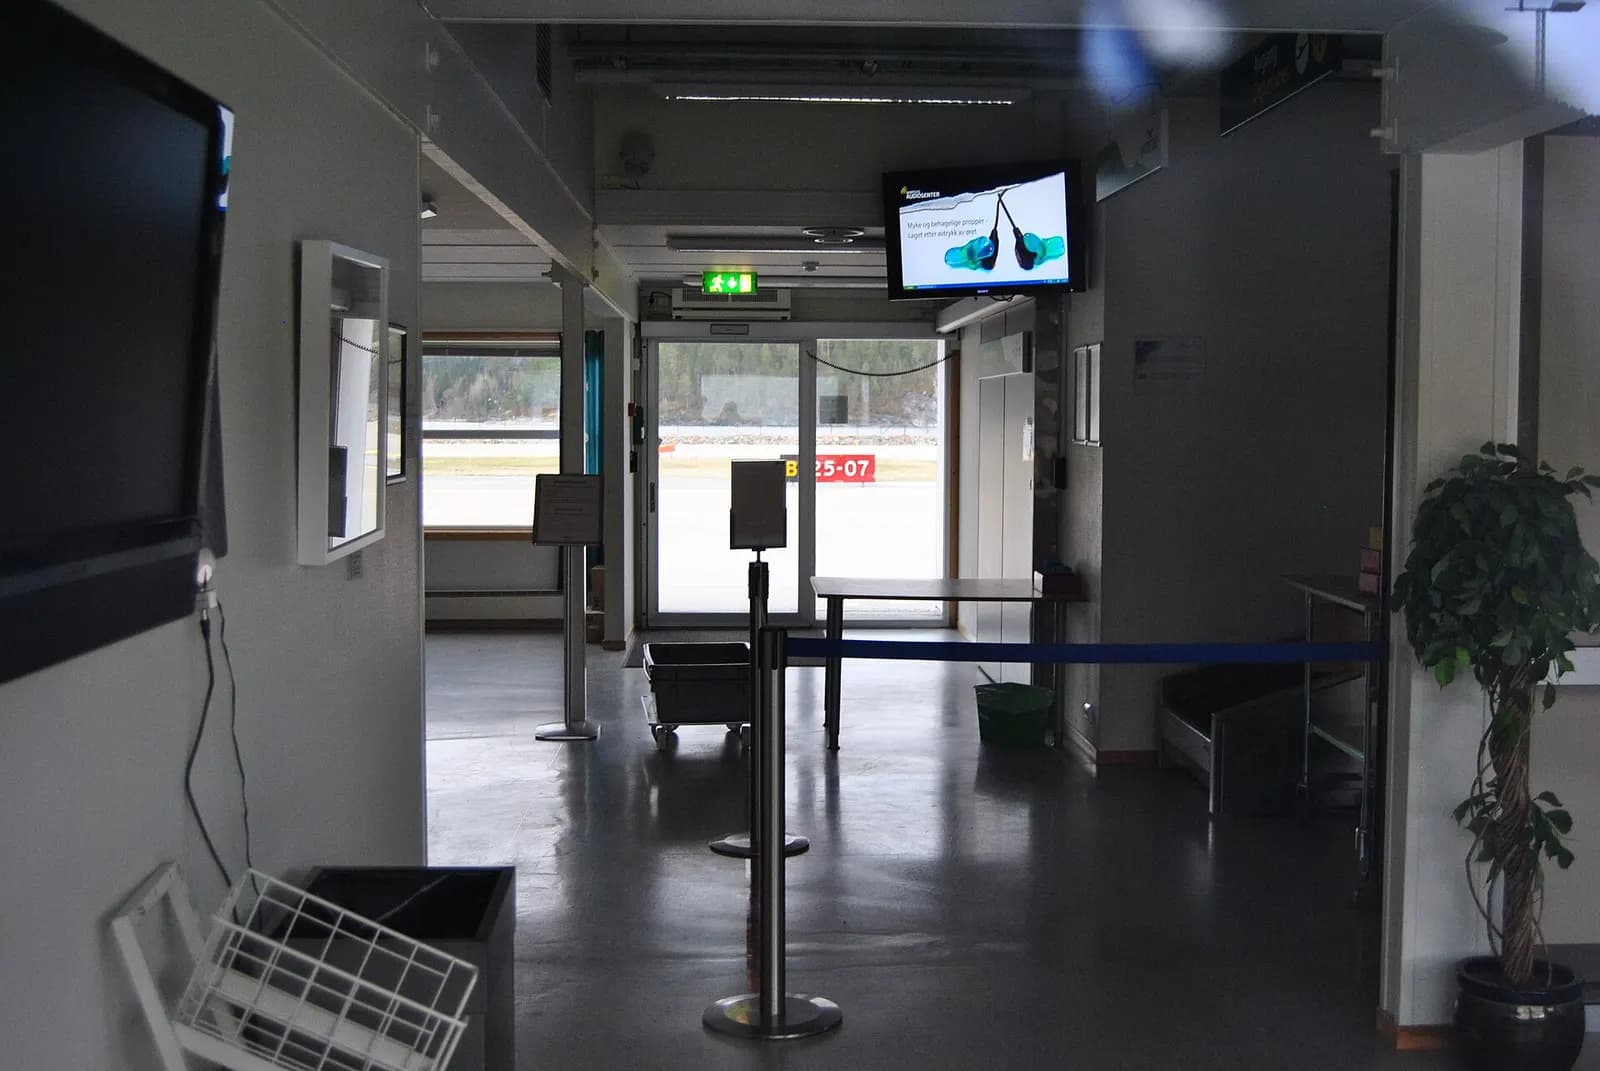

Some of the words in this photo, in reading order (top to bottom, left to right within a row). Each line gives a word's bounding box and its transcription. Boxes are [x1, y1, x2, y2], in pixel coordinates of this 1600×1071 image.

[906, 191, 940, 200] AUDIOSENTER
[931, 219, 961, 228] behagelige
[907, 232, 923, 240] Laget
[938, 230, 957, 238] avtrykk
[786, 460, 798, 476] B
